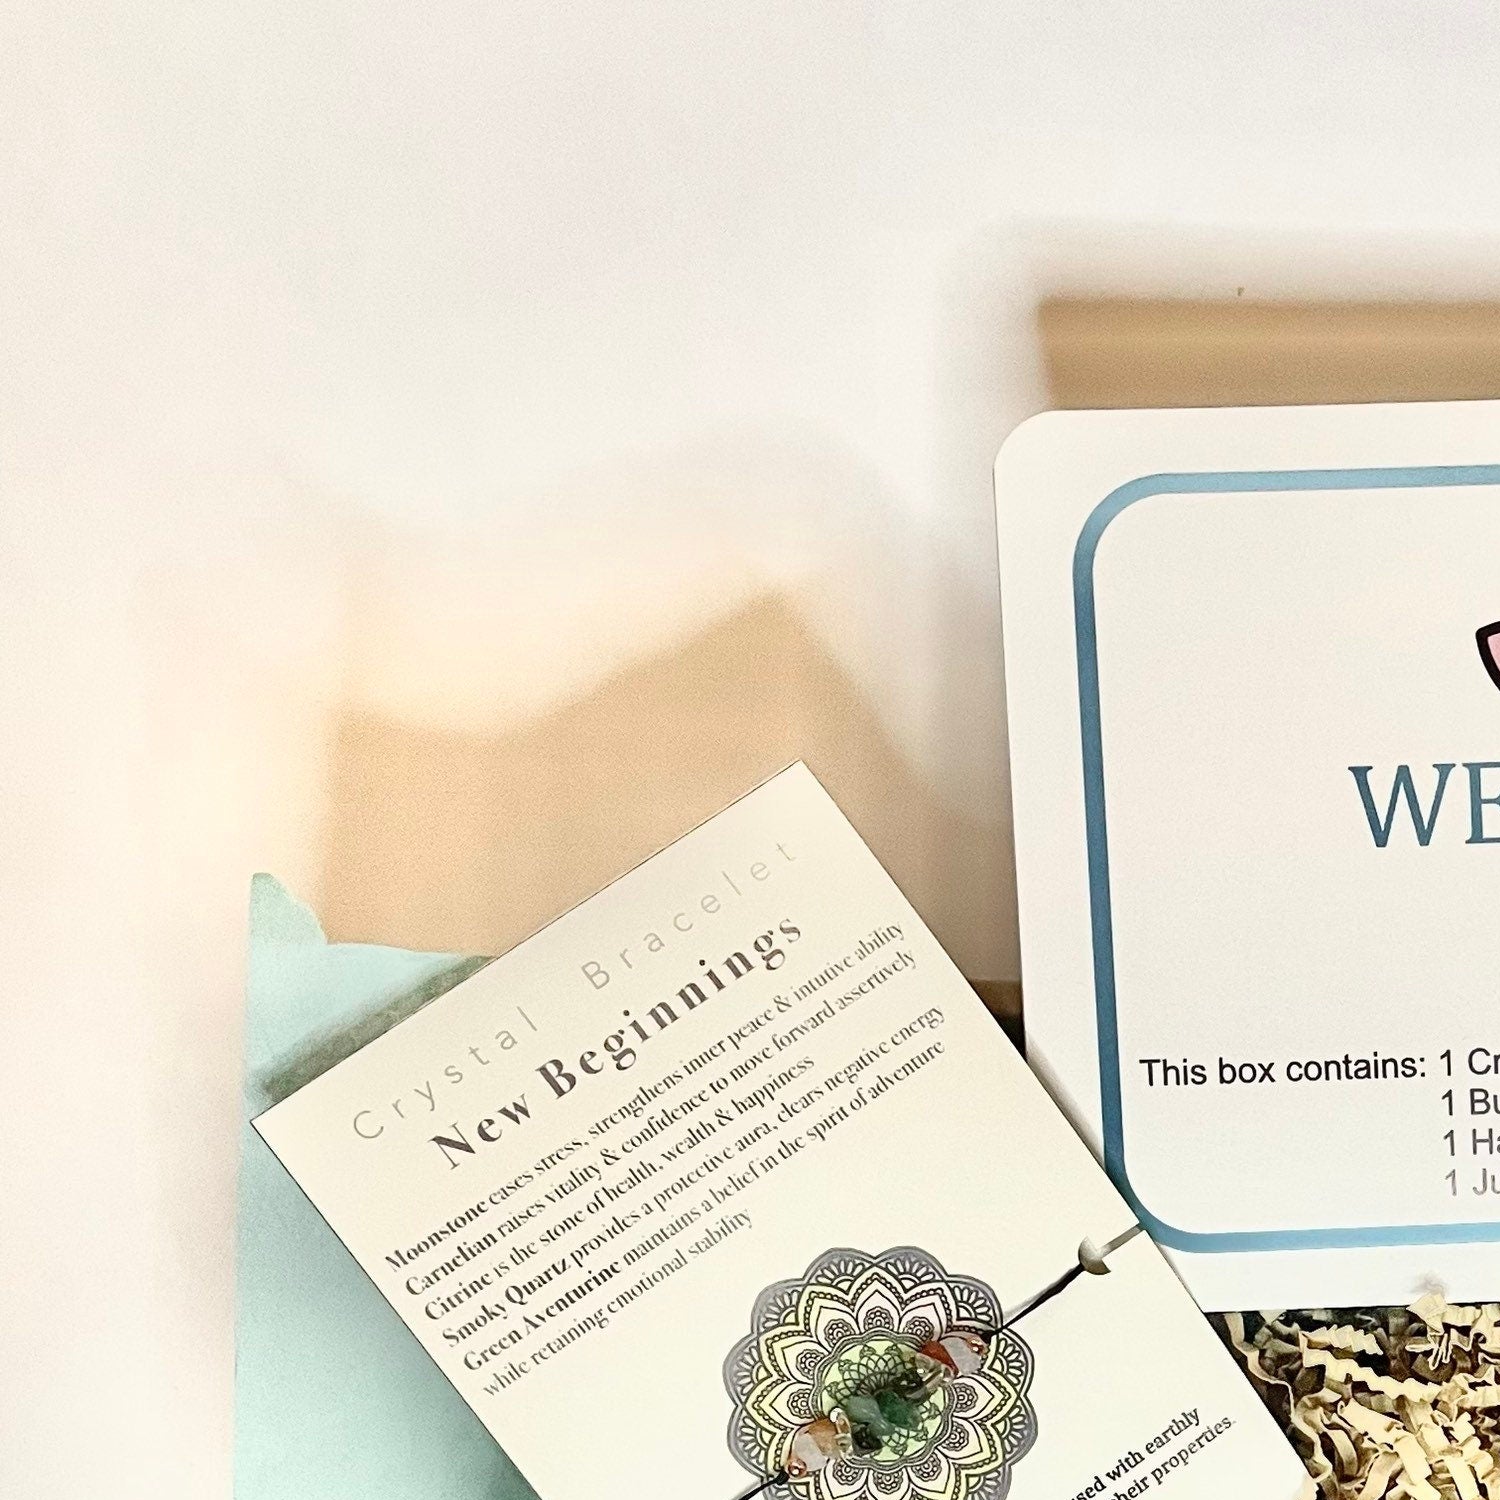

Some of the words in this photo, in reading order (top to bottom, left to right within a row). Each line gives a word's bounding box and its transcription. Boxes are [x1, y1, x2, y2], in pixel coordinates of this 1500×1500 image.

[353, 1006, 537, 1139] Crystal
[581, 839, 799, 990] Bracelet
[384, 1201, 489, 1273] Moonstone
[488, 1170, 534, 1205] eases
[533, 1138, 590, 1176] stress,
[588, 1070, 684, 1139] strengthens
[679, 1040, 726, 1076] inner
[726, 1009, 775, 1051] peace
[772, 995, 793, 1013] &
[854, 924, 904, 961] ability
[427, 1093, 531, 1170] New
[534, 918, 801, 1100] Beginnings
[1138, 1057, 1208, 1087] This
[1218, 1056, 1277, 1085] box
[1286, 1051, 1426, 1082] contains:
[1439, 1049, 1452, 1077] 1
[405, 1233, 499, 1296] Carnelian
[497, 1199, 546, 1238] raises
[544, 1162, 602, 1203] vitality
[599, 1148, 622, 1166] &
[621, 1089, 710, 1154] confidence
[708, 1077, 729, 1094] to
[729, 1047, 775, 1082] move
[771, 999, 836, 1052] forward
[835, 950, 916, 1011] assertively
[424, 1273, 494, 1320] Citrine
[492, 1261, 510, 1278] is
[509, 1242, 539, 1266] the
[538, 1210, 586, 1247] stone
[586, 1190, 606, 1215] of
[601, 1160, 664, 1202] health,
[660, 1120, 717, 1162] wealth
[714, 1108, 735, 1127] &
[730, 1056, 815, 1115] happiness
[442, 1303, 508, 1348] Smoky
[504, 1258, 572, 1306] Quartz
[569, 1210, 642, 1269] provides
[640, 1202, 654, 1216] a
[653, 1146, 735, 1212] protective
[734, 1122, 779, 1152] aura,
[777, 1086, 825, 1123] clears
[824, 1041, 891, 1092] negative
[890, 1007, 945, 1046] energy
[463, 1329, 524, 1371] Green
[522, 1261, 622, 1336] Aventurine
[622, 1207, 701, 1266] maintains
[700, 1199, 714, 1213] a
[708, 1160, 760, 1204] belief
[756, 1155, 779, 1173] in
[777, 1136, 806, 1160] the
[806, 1106, 850, 1142] spirit
[849, 1087, 868, 1111] of
[867, 1041, 945, 1099] adventure
[1441, 1089, 1453, 1117] 1
[1443, 1129, 1456, 1157] 1
[1444, 1168, 1457, 1197] 1
[483, 1361, 531, 1396] while
[530, 1308, 610, 1366] retaining
[606, 1248, 688, 1314] emotional
[688, 1208, 752, 1258] stability
[1105, 1451, 1146, 1481] with
[1145, 1408, 1200, 1455] earthly
[1150, 1417, 1236, 1486] properties.
